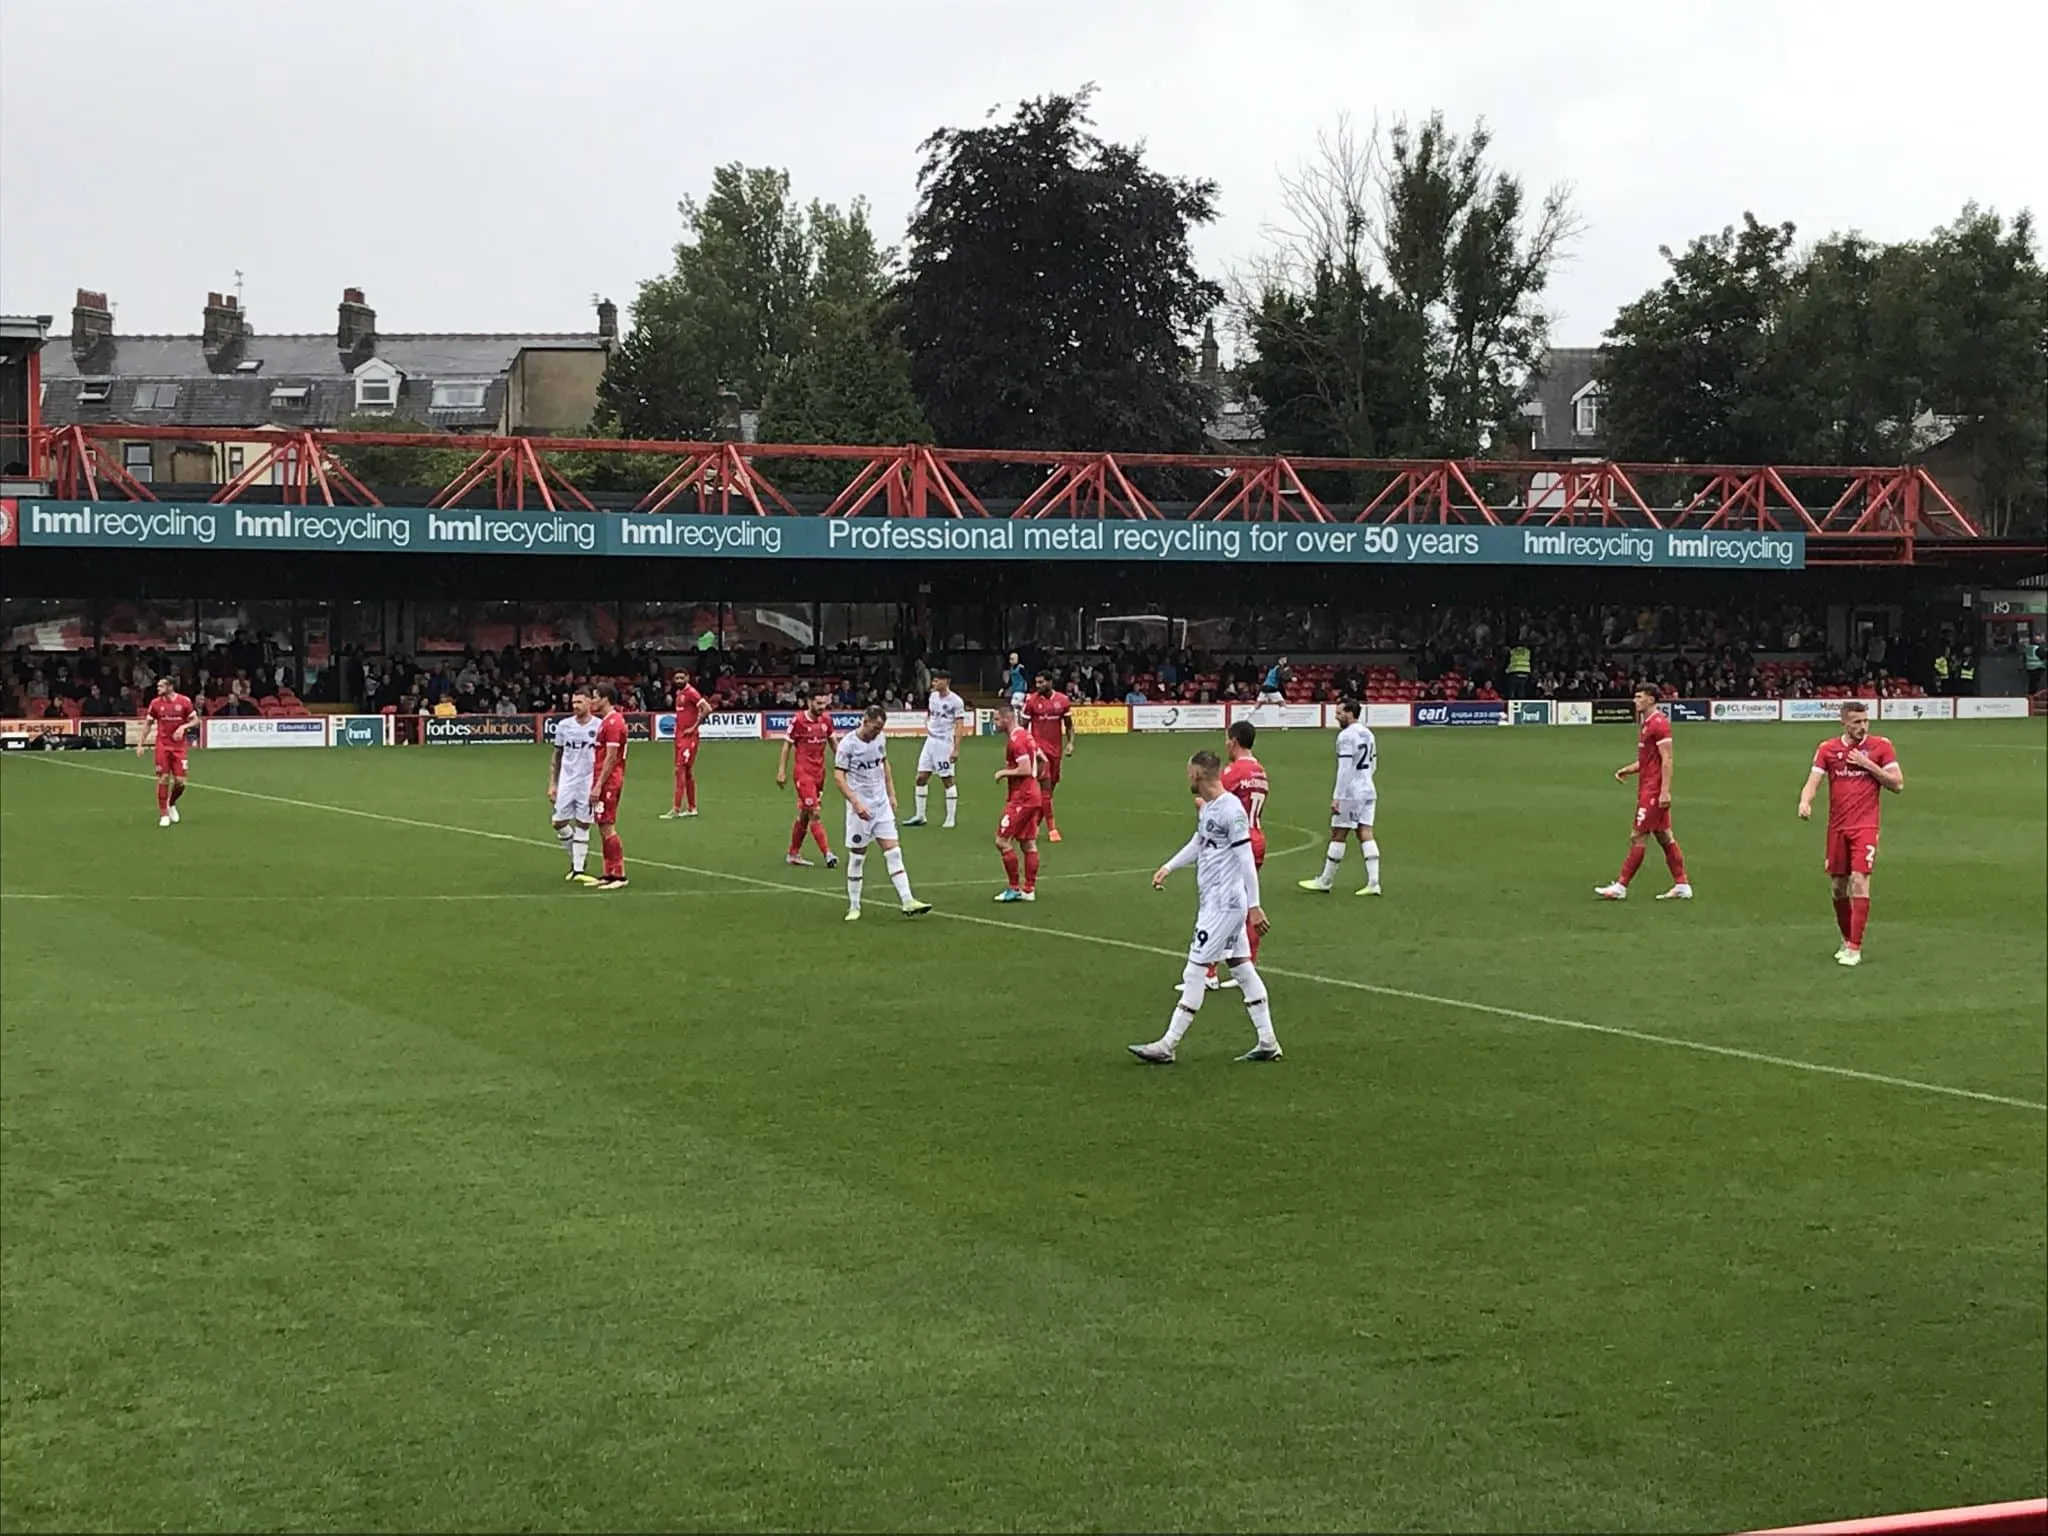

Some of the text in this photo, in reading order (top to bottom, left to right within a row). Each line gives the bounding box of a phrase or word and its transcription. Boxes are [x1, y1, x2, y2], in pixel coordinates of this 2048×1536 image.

[828, 519, 1480, 562] Professional metal recycling for over 50 years
[1726, 703, 1777, 714] FCL Fostering
[702, 714, 757, 727] ARVIEW
[832, 717, 863, 727] WSON
[1522, 711, 1540, 722] hml
[18, 722, 66, 733] Factory
[83, 726, 123, 737] ARDEN
[231, 722, 275, 733] BAKER
[349, 727, 371, 739] hml
[1636, 807, 1647, 822] 5
[1000, 815, 1010, 829] 6
[1865, 845, 1876, 861] 2
